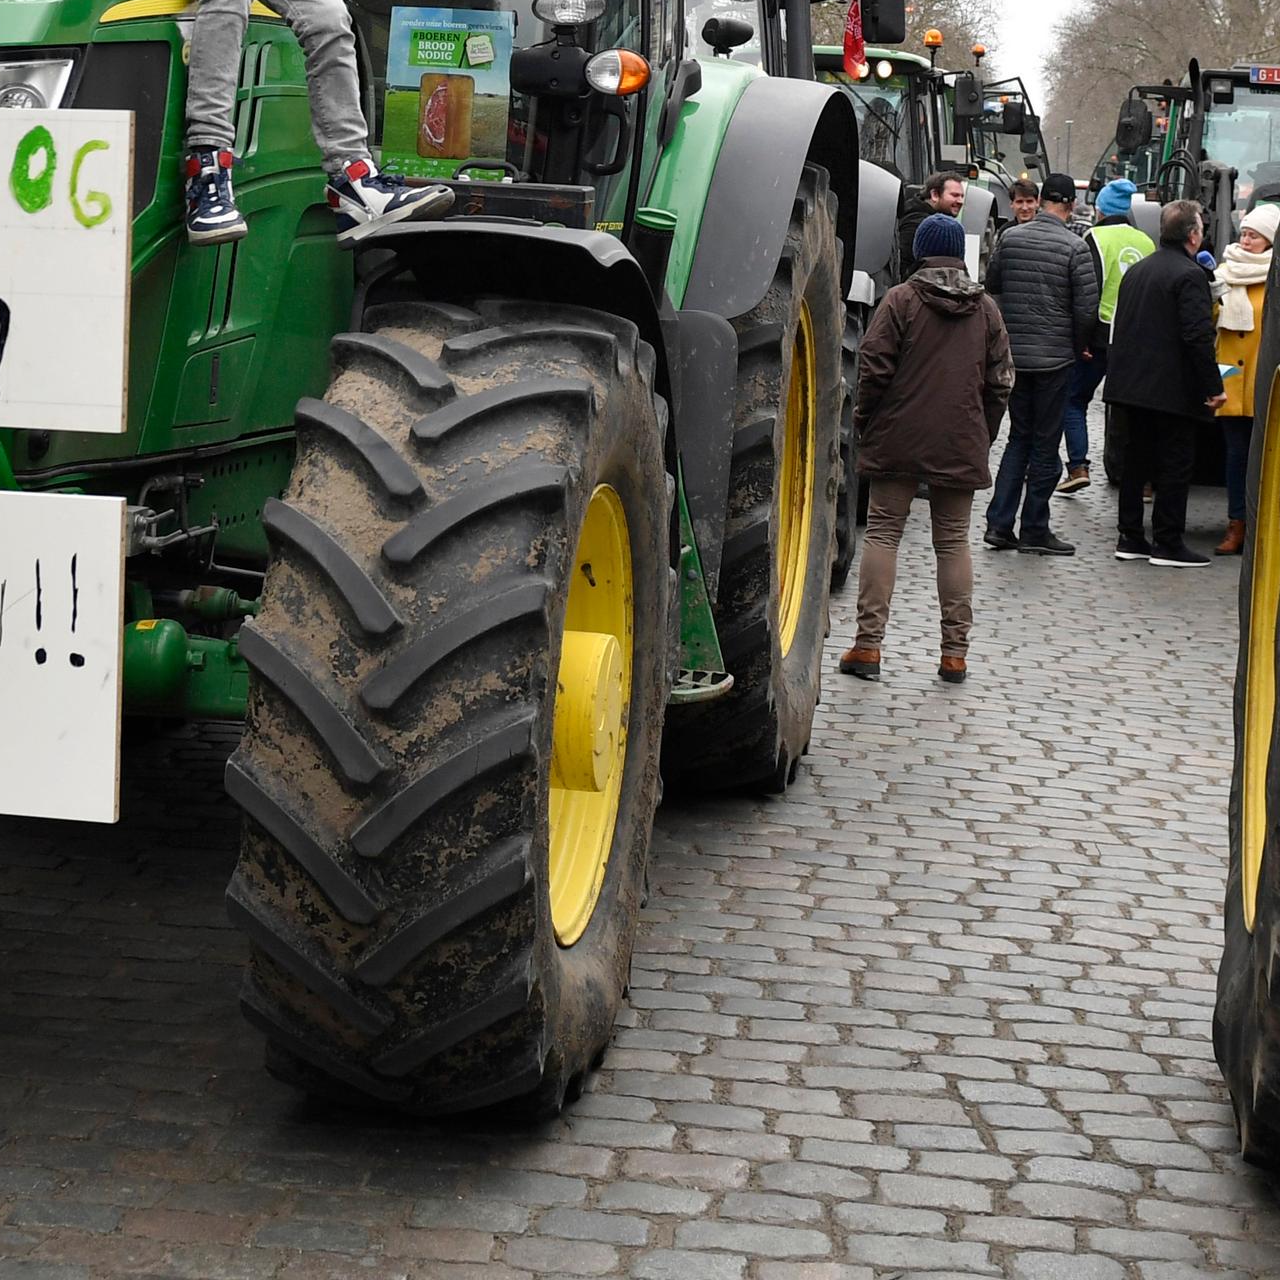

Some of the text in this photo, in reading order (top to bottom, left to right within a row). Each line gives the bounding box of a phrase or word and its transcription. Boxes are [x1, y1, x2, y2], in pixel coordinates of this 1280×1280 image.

[413, 31, 460, 42] #BOEREN
[418, 41, 455, 51] BROOD
[417, 51, 452, 60] NODIG
